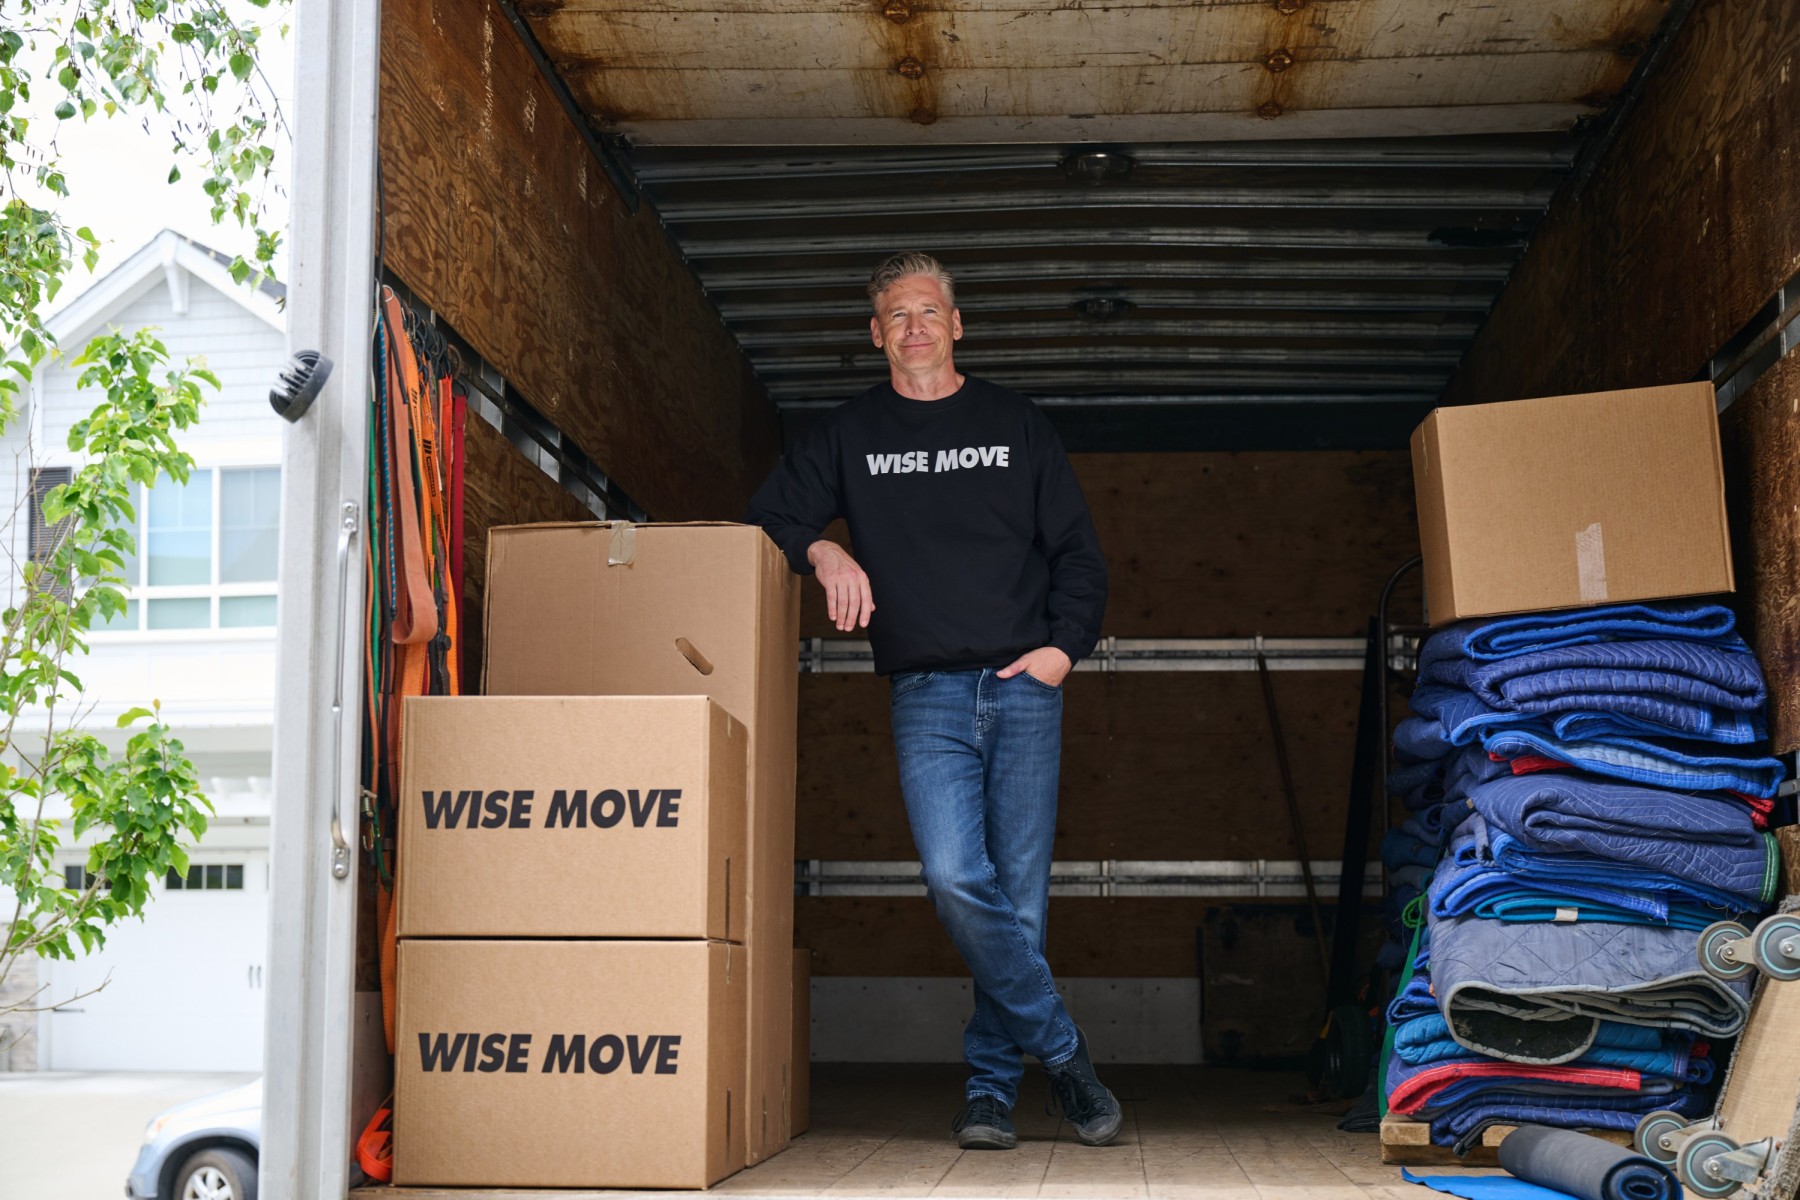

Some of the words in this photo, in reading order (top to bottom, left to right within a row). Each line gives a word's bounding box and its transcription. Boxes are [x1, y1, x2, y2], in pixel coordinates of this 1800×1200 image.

[866, 450, 929, 475] WISE
[934, 446, 1010, 473] MOVE
[422, 790, 534, 829] WISE
[544, 789, 682, 828] MOVE
[418, 1032, 532, 1073] WISE
[541, 1034, 682, 1075] MOVE
